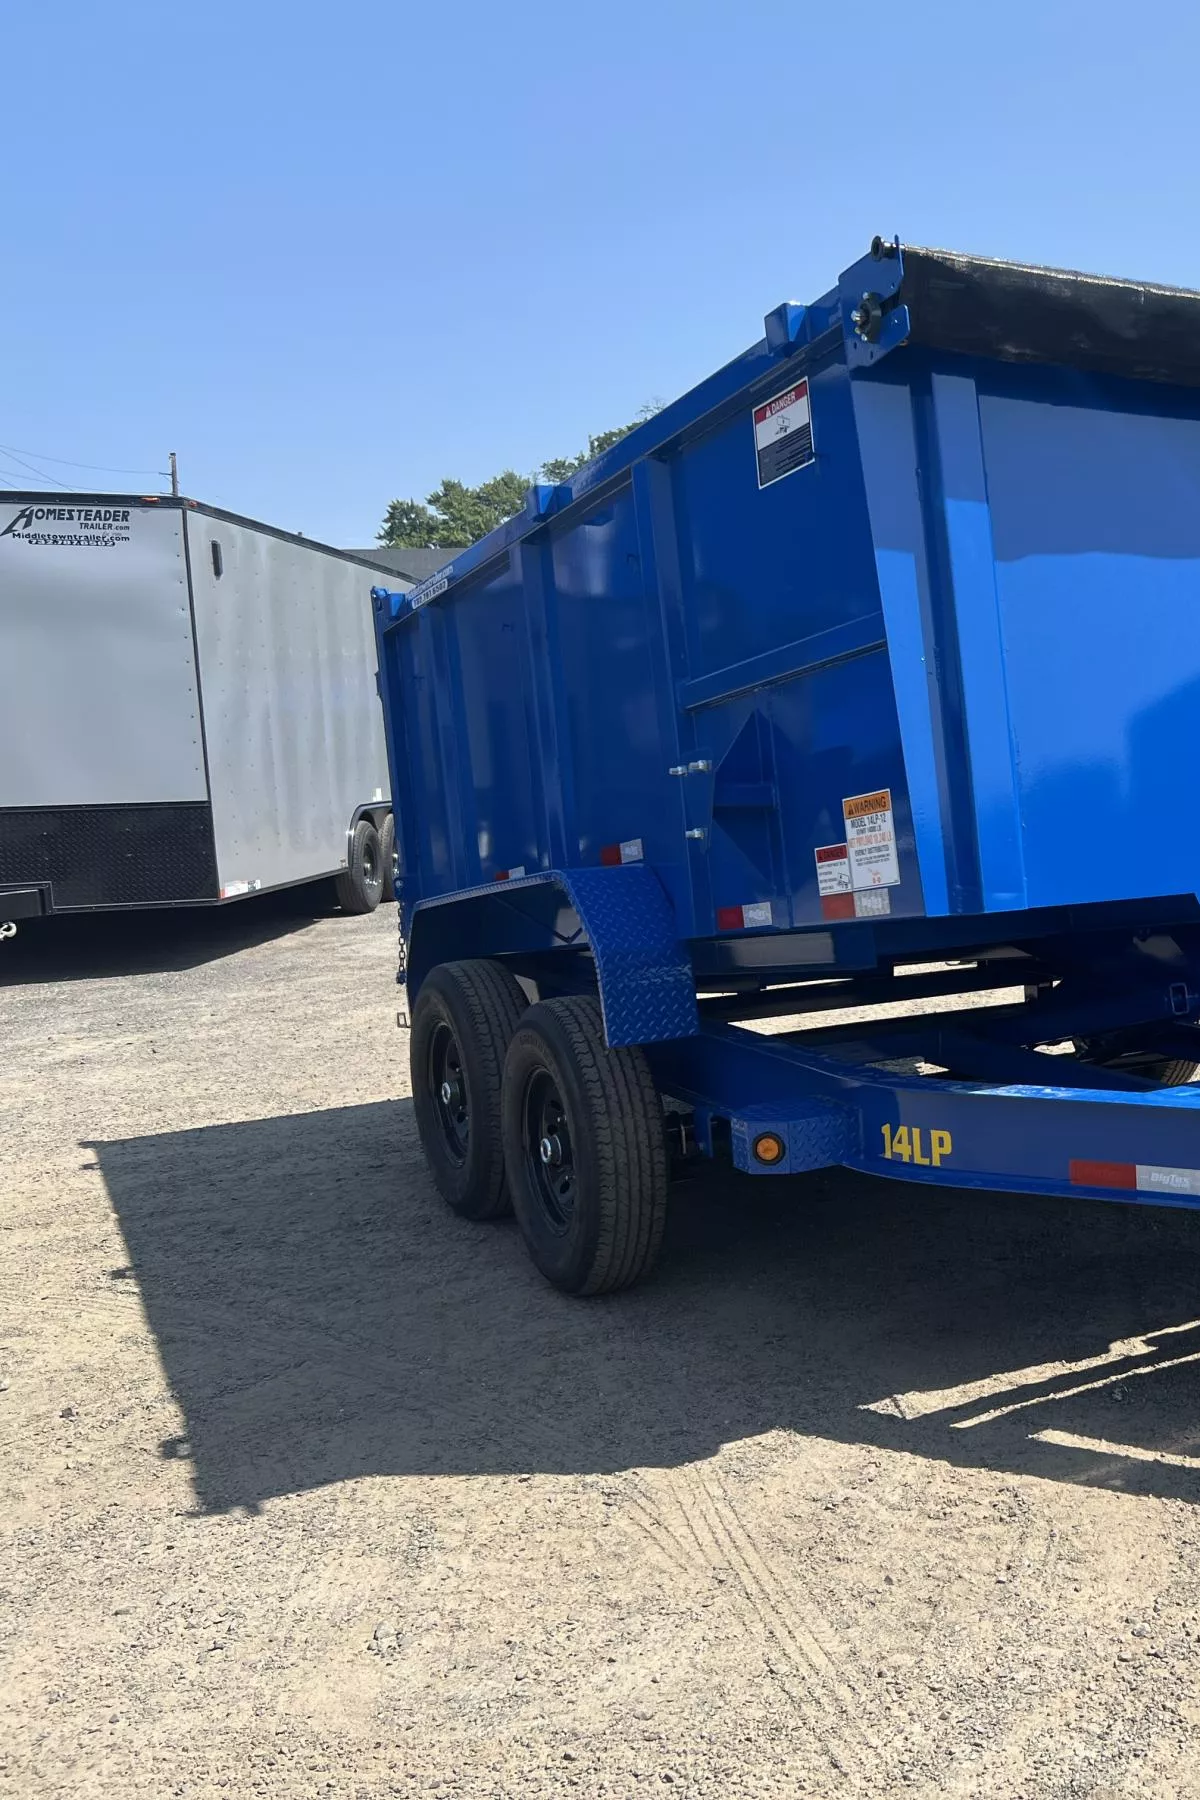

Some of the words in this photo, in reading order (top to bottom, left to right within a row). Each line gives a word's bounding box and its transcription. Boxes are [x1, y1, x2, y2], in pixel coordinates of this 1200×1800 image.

[771, 391, 796, 413] DANGER
[0, 506, 130, 536] HOMESTEADER
[12, 532, 130, 542] Middletowntrailer.com
[854, 796, 887, 813] WARNING
[881, 1123, 952, 1167] 14LP
